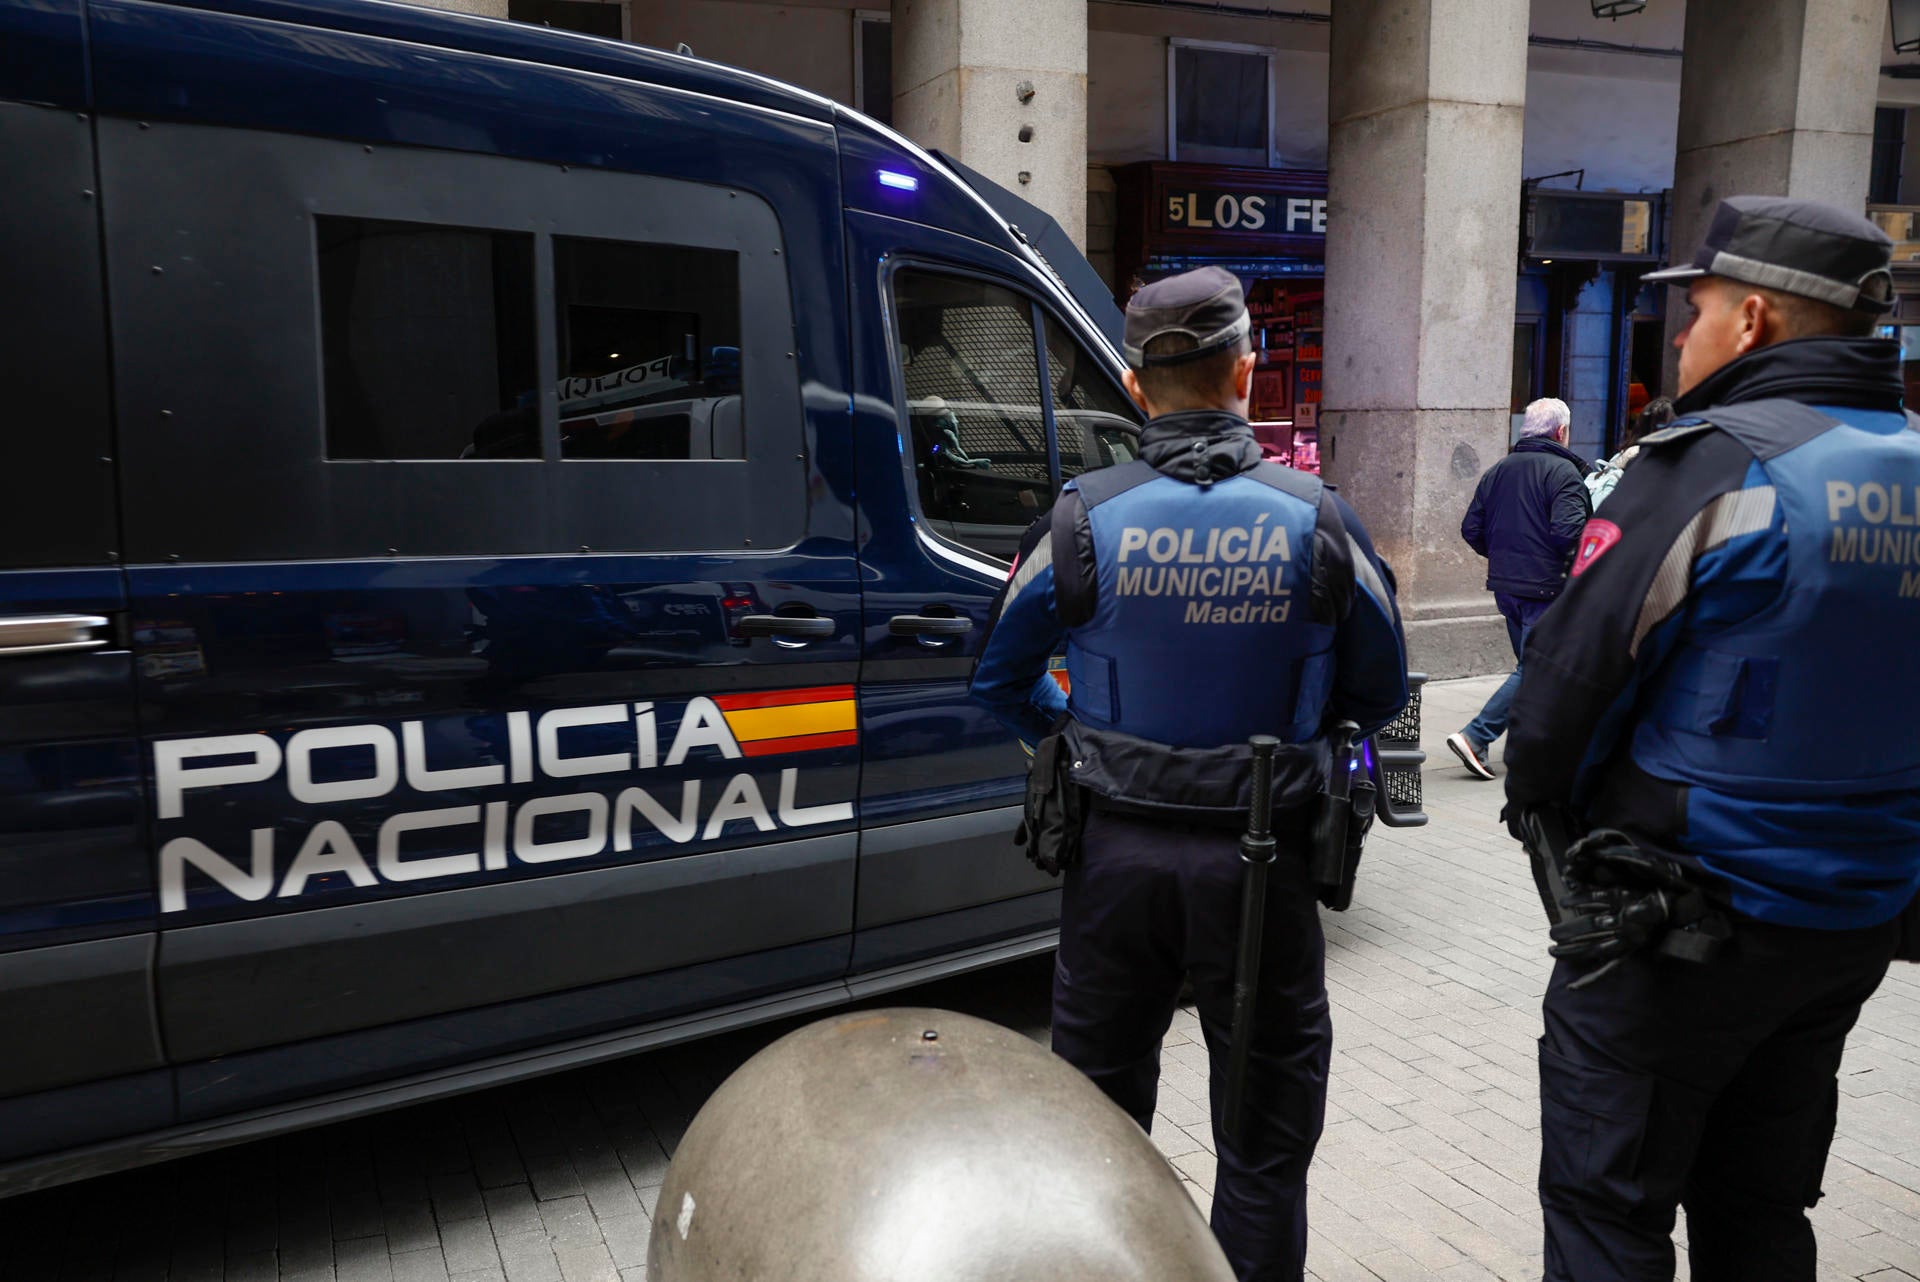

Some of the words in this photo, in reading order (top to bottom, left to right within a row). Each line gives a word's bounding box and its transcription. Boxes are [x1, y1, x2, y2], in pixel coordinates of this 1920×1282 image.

[1168, 197, 1184, 221] 5
[1187, 193, 1266, 229] LOS
[1117, 512, 1291, 563] POLICÍA
[1116, 566, 1291, 596] MUNICIPAL
[1184, 601, 1290, 623] Madrid
[158, 767, 854, 913] NACIONAL
